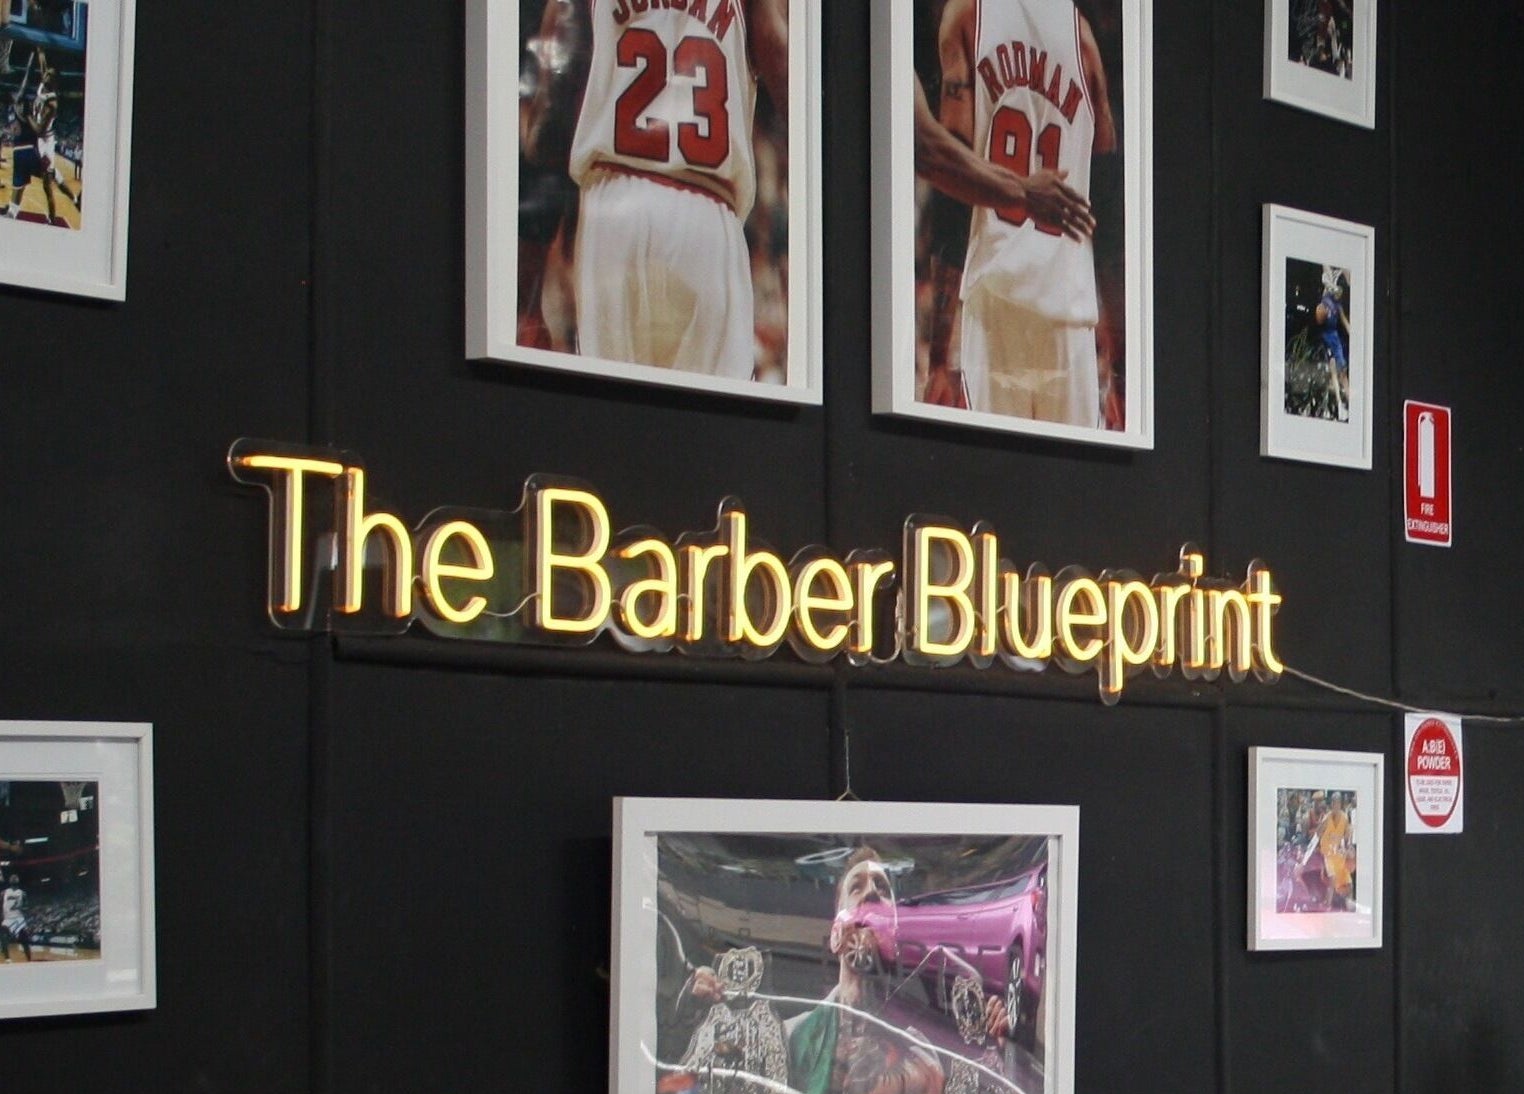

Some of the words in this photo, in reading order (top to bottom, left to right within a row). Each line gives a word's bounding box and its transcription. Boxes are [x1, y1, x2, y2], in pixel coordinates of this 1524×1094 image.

[613, 28, 729, 168] 23
[977, 41, 1082, 126] RODMAN
[1420, 502, 1435, 517] FIRE
[238, 453, 496, 624] The
[534, 486, 897, 655] Barber
[912, 518, 1286, 697] Blueprint
[1416, 755, 1452, 770] POWDER
